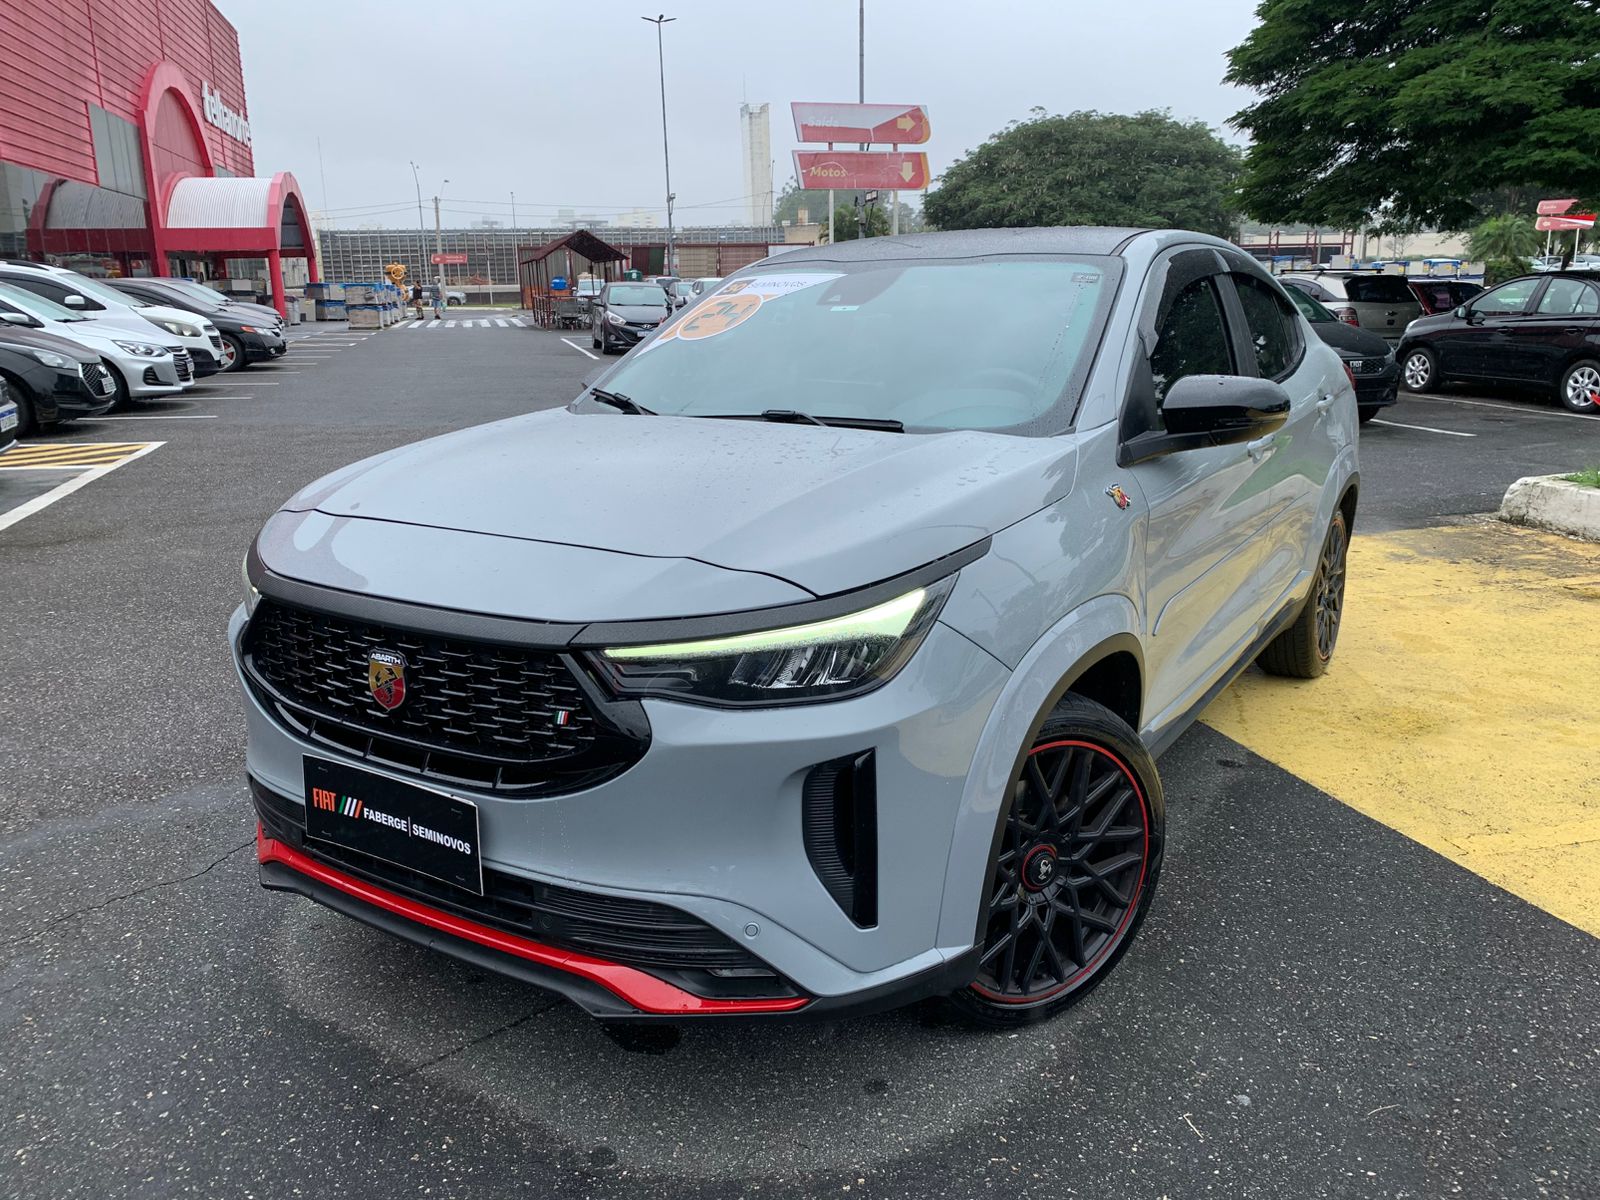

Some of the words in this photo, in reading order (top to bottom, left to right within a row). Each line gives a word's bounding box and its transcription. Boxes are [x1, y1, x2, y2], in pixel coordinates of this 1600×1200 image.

[202, 80, 252, 148] telhanorte
[809, 166, 847, 177] Motos
[370, 653, 401, 664] ABARTH
[312, 787, 337, 812] FIAT
[363, 807, 408, 832] FABERGE
[412, 824, 472, 855] SEMINOVOS
